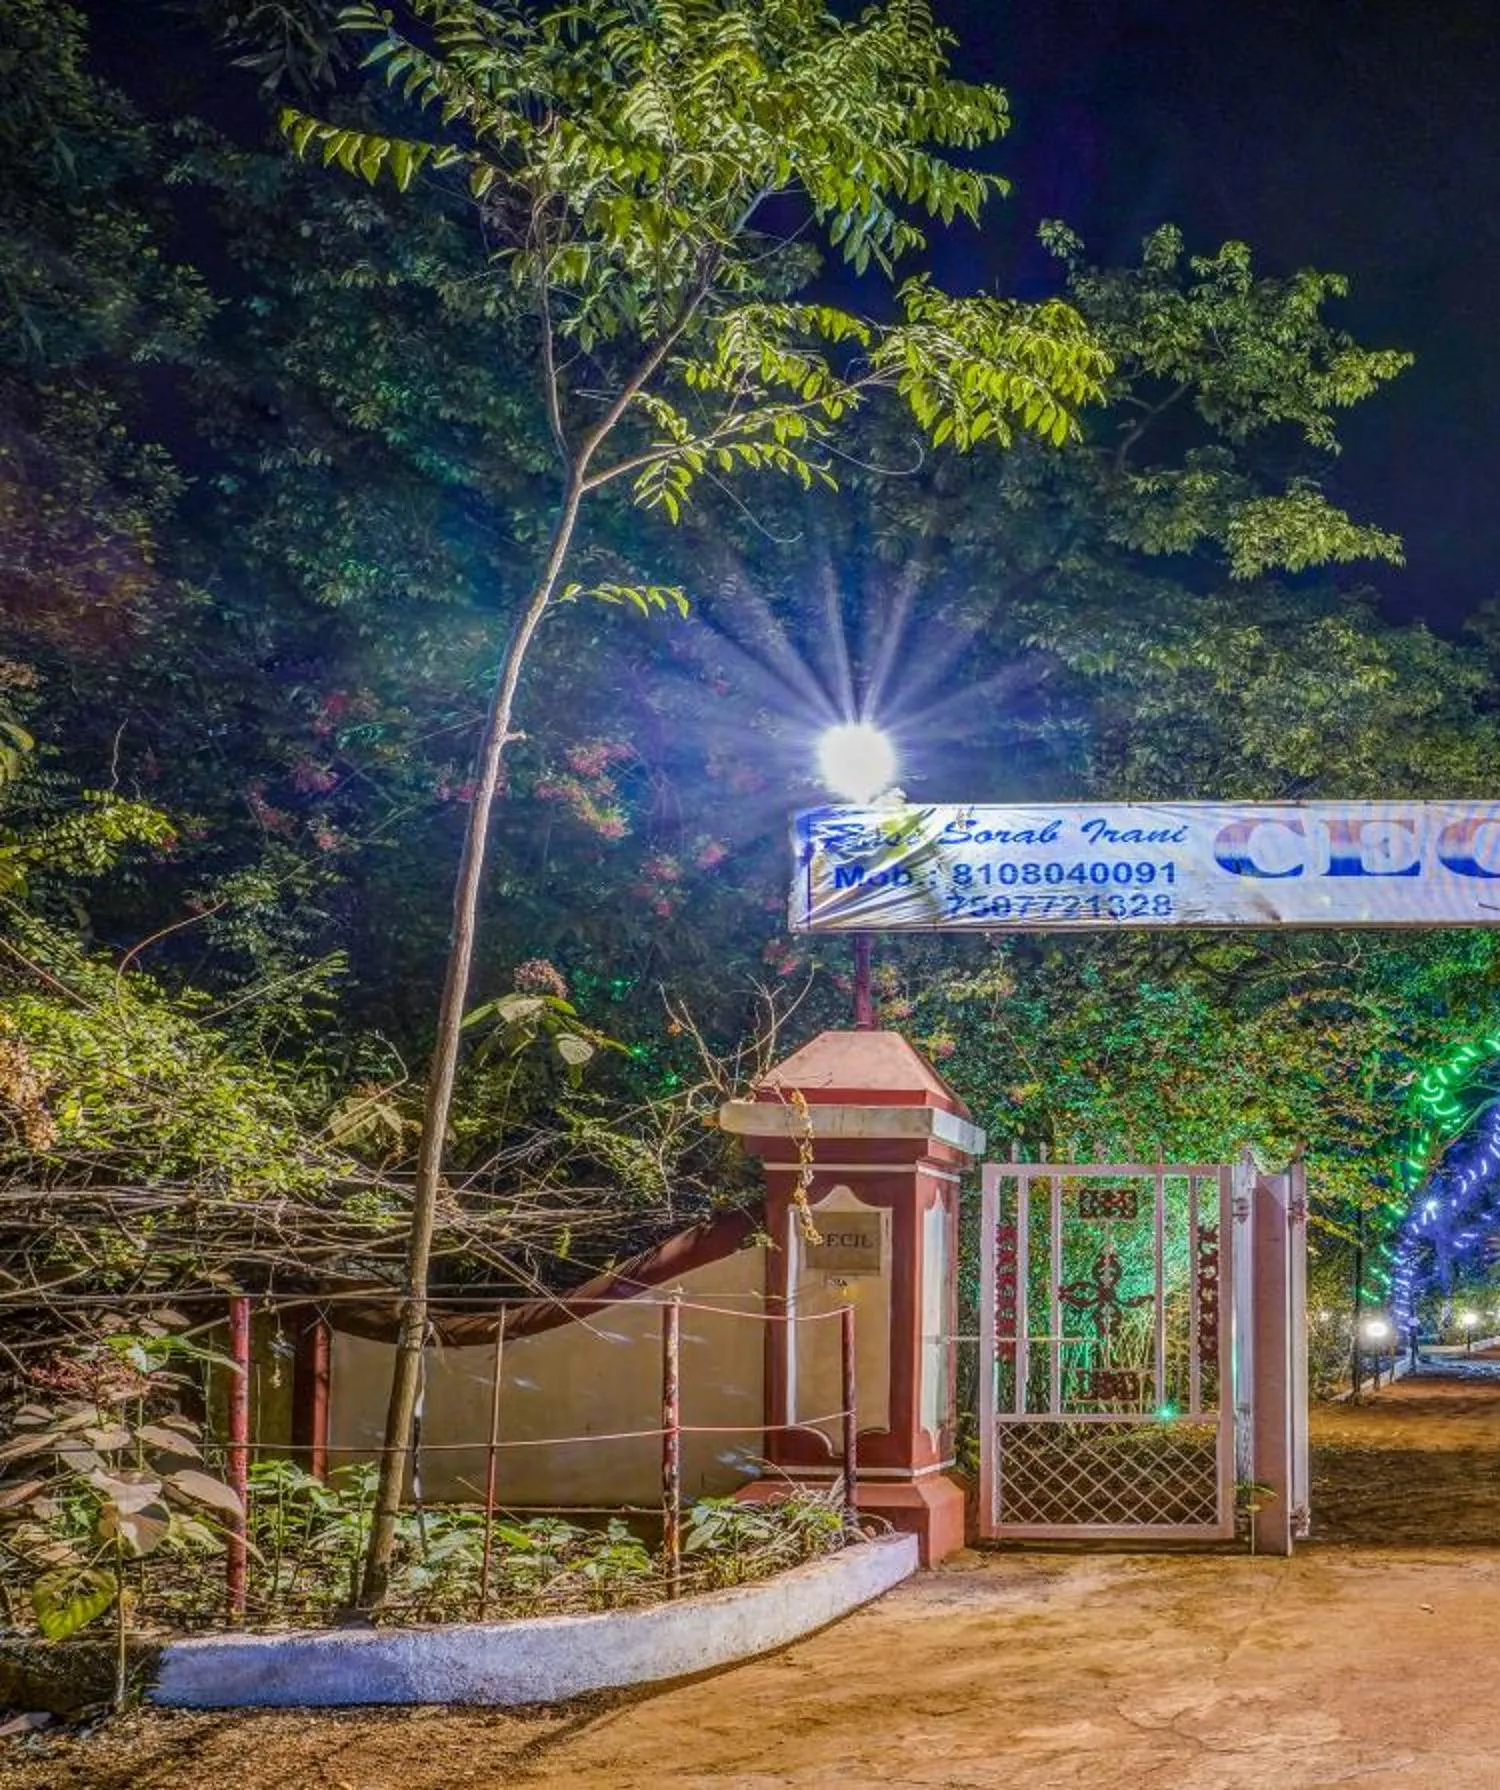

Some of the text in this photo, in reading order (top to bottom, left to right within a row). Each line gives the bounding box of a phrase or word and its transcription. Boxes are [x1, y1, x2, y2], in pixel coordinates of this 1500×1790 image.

[935, 818, 1063, 847] Sorab
[1079, 817, 1190, 846] Irani
[951, 861, 1177, 886] 8108040091
[811, 1231, 875, 1249] ECIL
